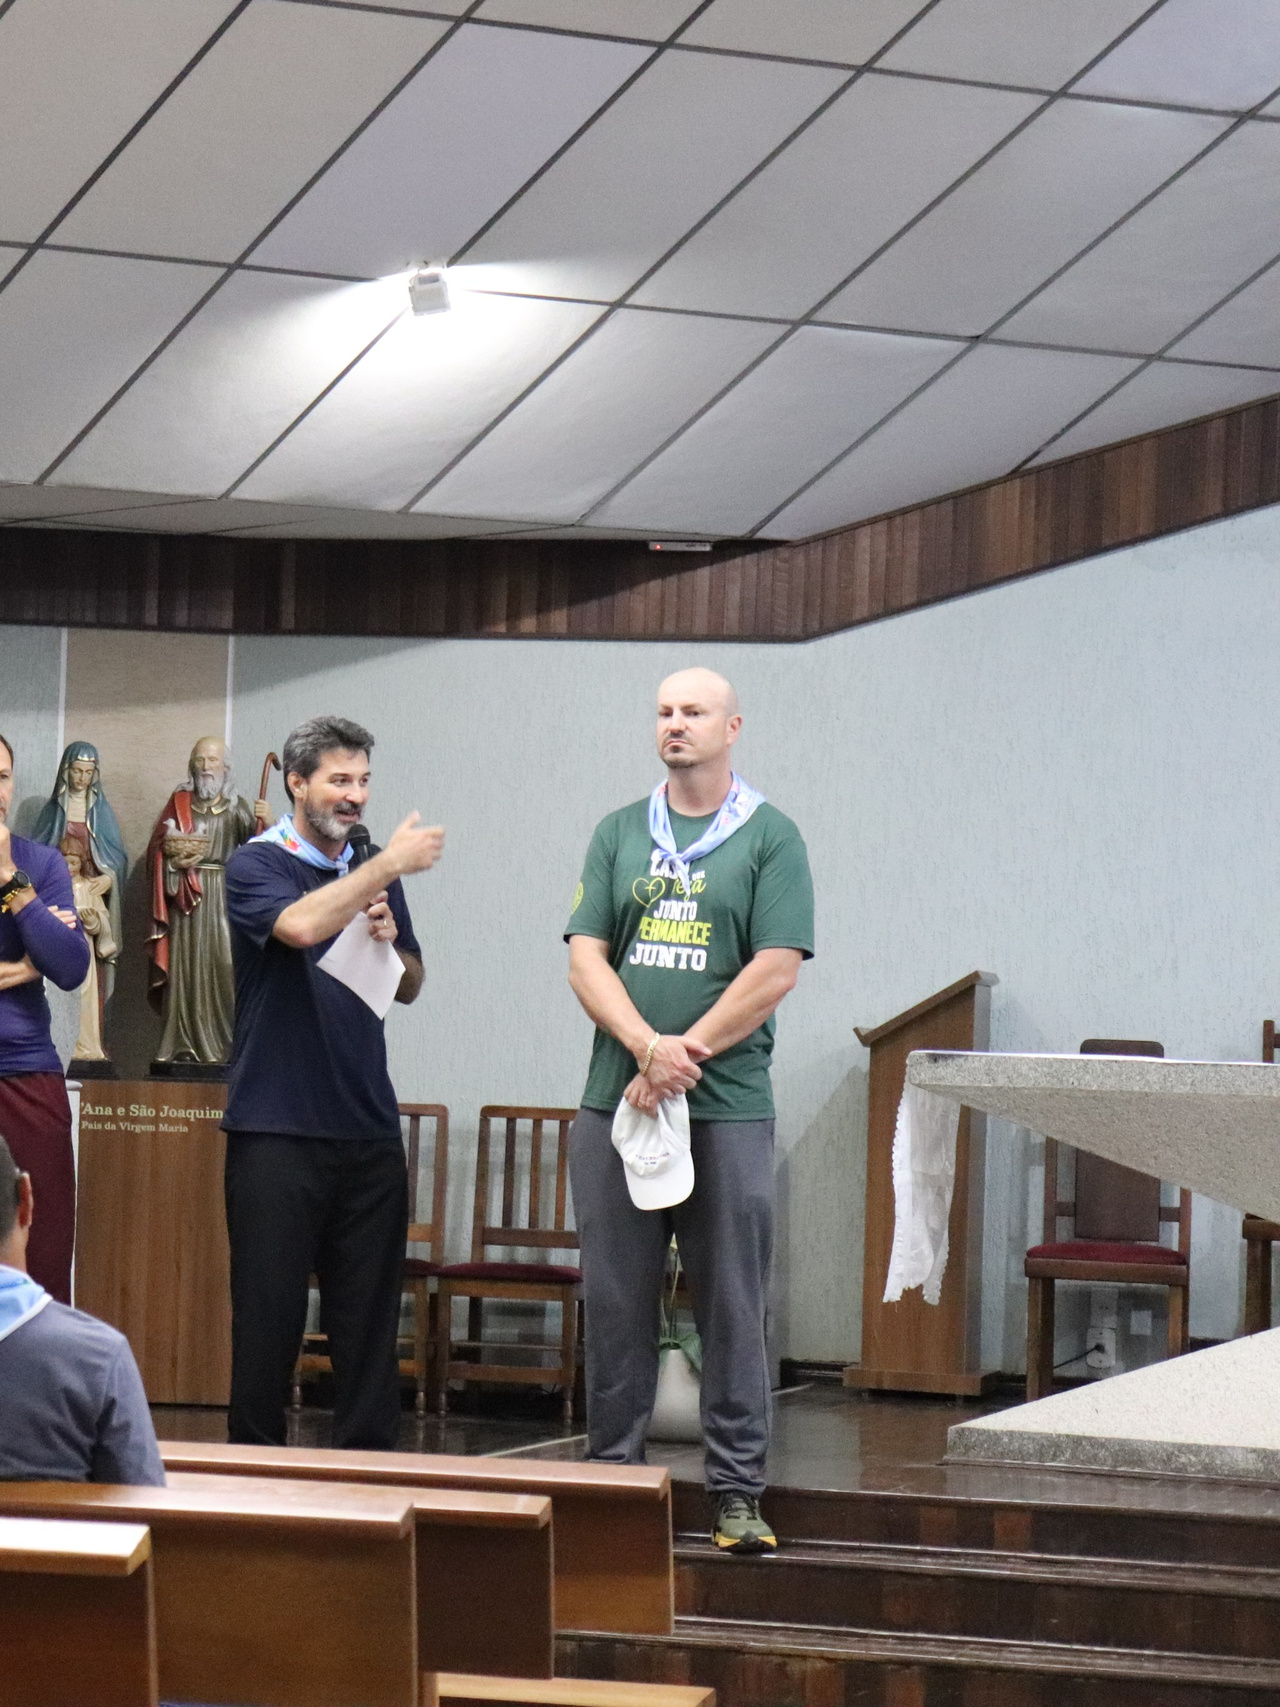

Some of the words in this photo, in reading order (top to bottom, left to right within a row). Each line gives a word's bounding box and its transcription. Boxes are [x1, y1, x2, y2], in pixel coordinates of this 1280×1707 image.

[653, 900, 698, 921] JUNTO
[629, 943, 708, 972] JUNTO
[117, 1107, 125, 1116] e
[129, 1104, 156, 1117] São
[160, 1105, 224, 1122] Joaquim
[81, 1121, 102, 1130] Pais
[104, 1122, 117, 1131] da
[120, 1122, 156, 1134] Virgem
[158, 1124, 189, 1134] Maria
